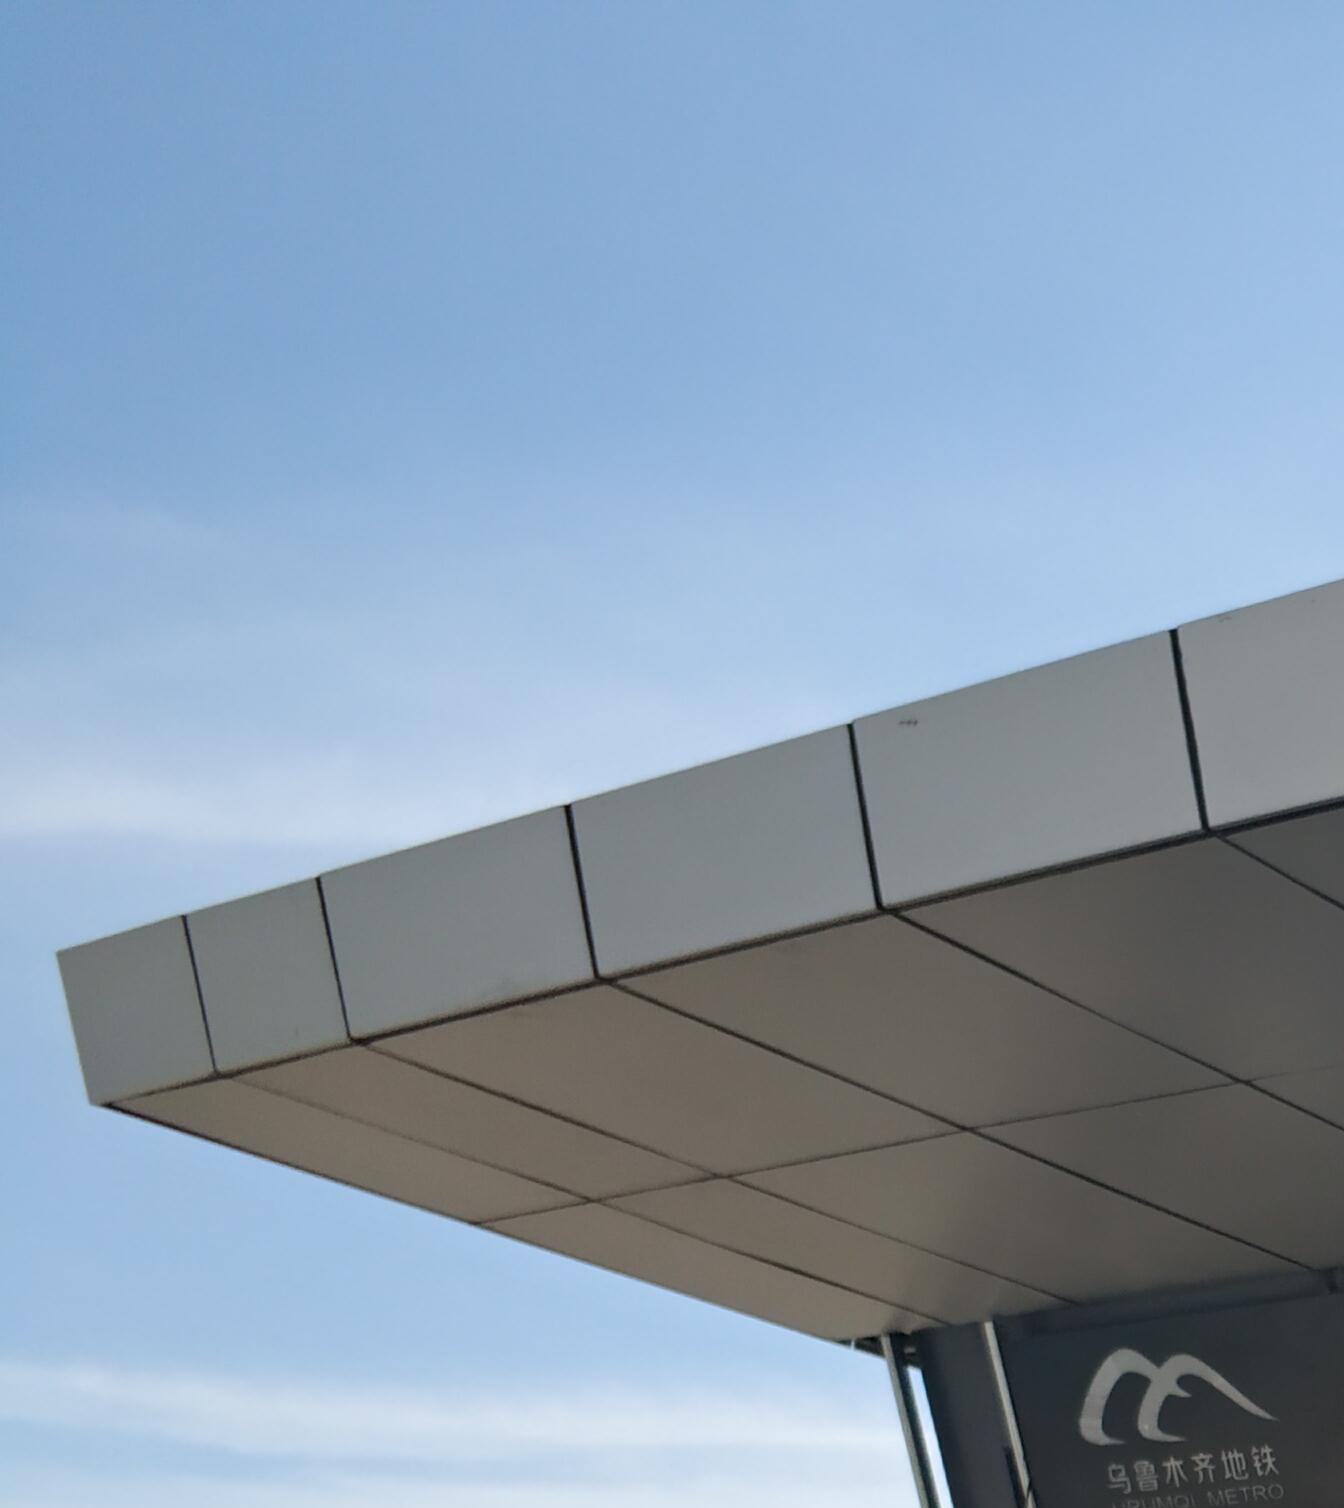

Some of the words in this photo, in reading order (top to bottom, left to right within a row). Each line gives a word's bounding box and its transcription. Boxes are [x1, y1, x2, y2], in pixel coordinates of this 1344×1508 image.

[1107, 1445, 1280, 1494] 乌鲁木齐地铁
[1207, 1484, 1285, 1507] METRO
